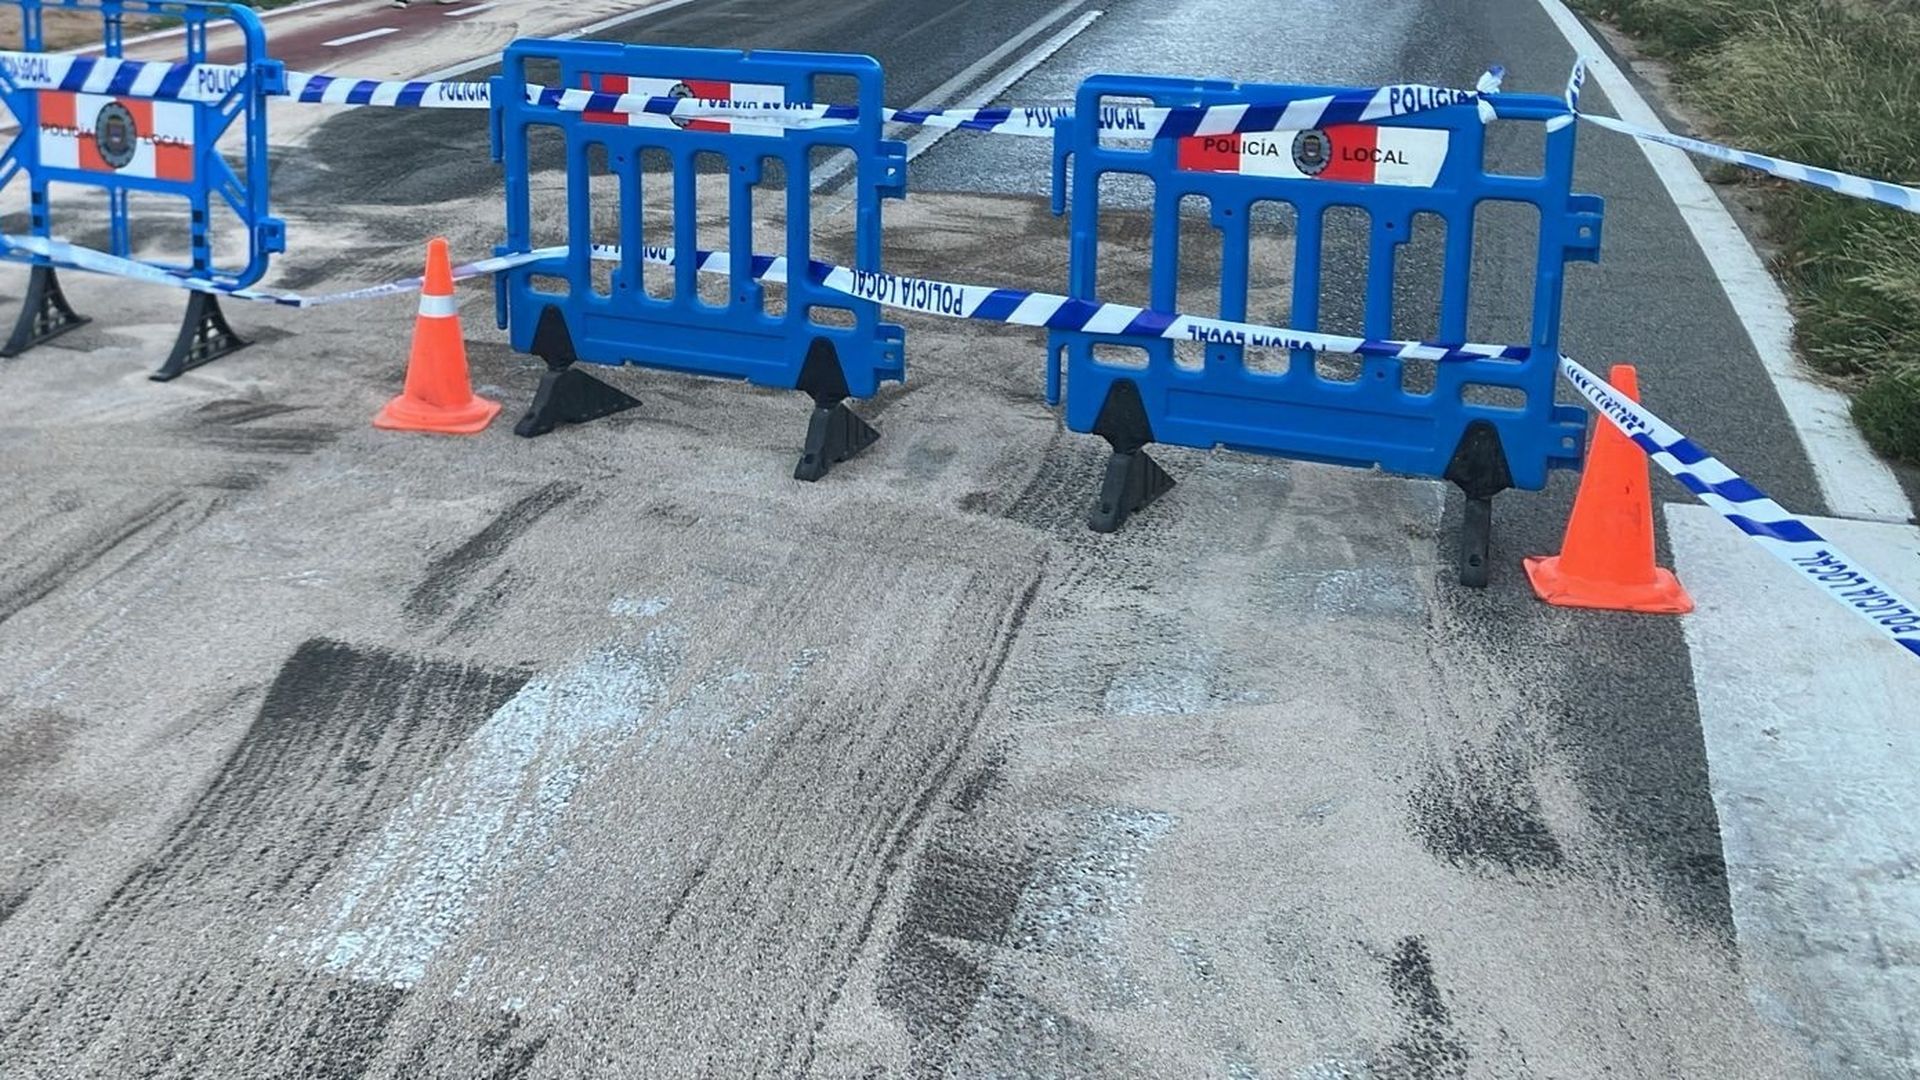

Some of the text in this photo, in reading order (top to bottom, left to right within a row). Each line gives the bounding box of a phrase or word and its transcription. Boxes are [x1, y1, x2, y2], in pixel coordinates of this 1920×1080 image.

[198, 68, 241, 94] POLIC
[143, 133, 190, 149] LOCAL
[1203, 137, 1409, 165] POLICÍA LOCAL
[850, 268, 965, 316] POLICIA LOCAL
[1791, 549, 1920, 635] POLICIA LOCAL
